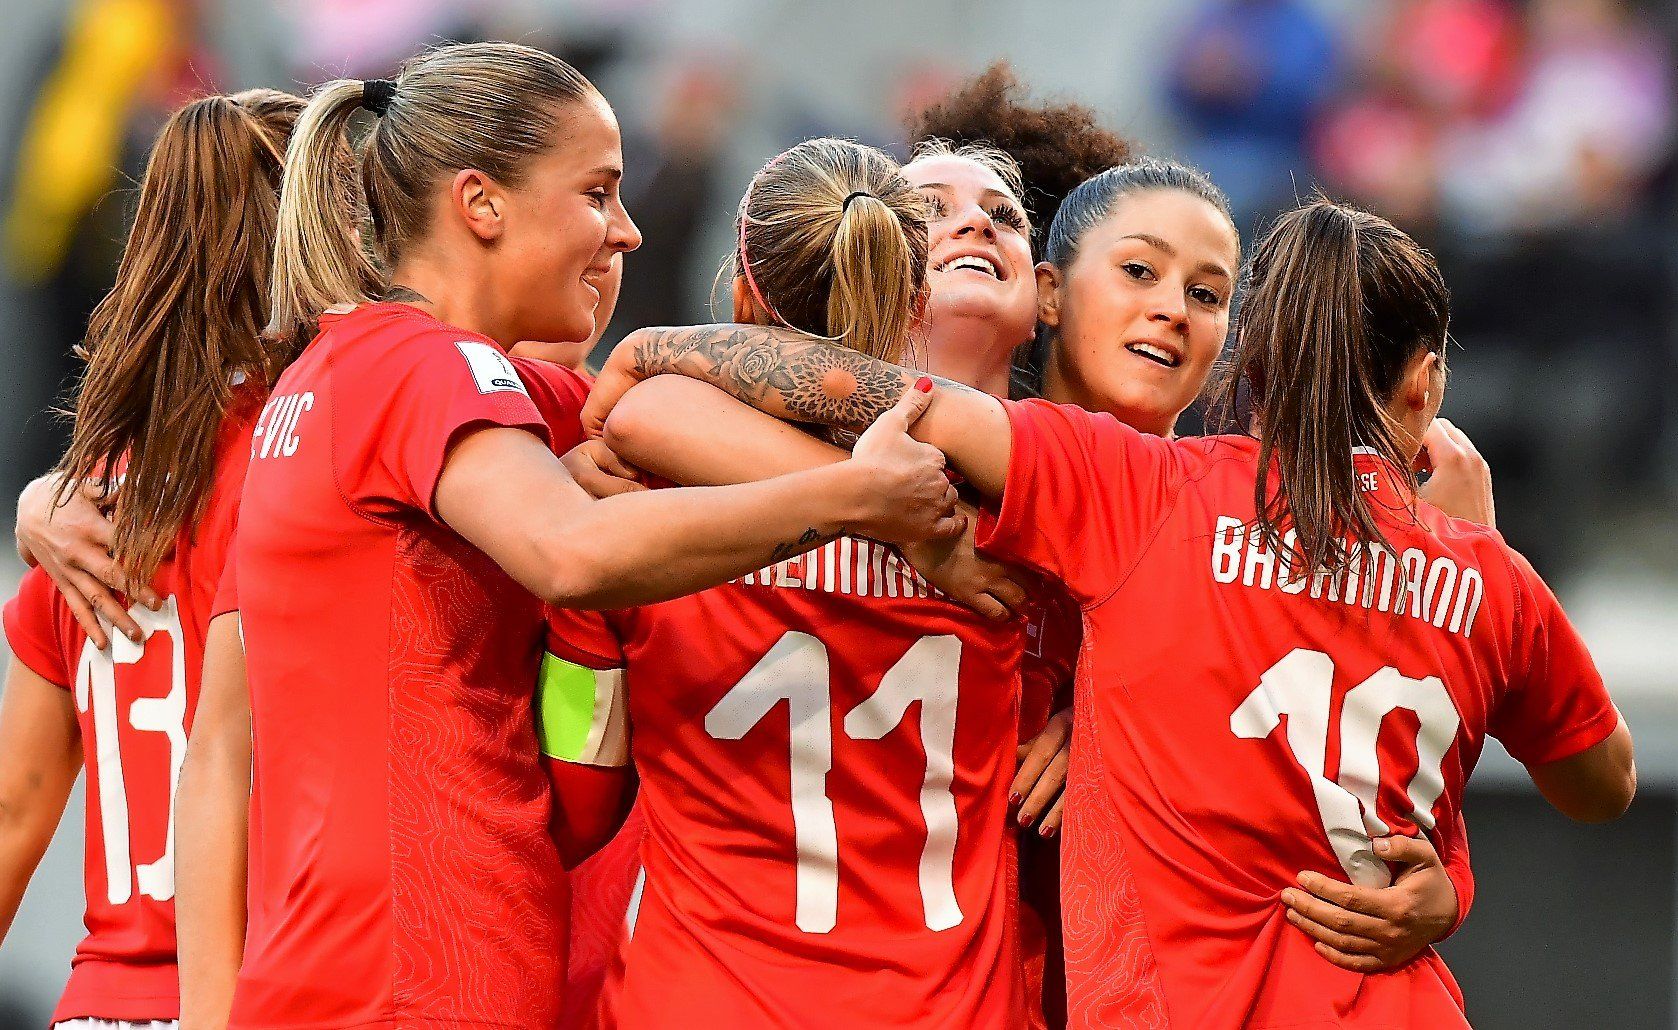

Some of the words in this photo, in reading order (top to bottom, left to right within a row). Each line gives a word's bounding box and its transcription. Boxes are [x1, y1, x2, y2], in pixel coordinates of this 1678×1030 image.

[1211, 515, 1483, 638] BACHMANN
[1356, 471, 1379, 492] SE
[75, 593, 188, 904] 13
[705, 631, 963, 934] 11
[1230, 648, 1461, 888] 10
